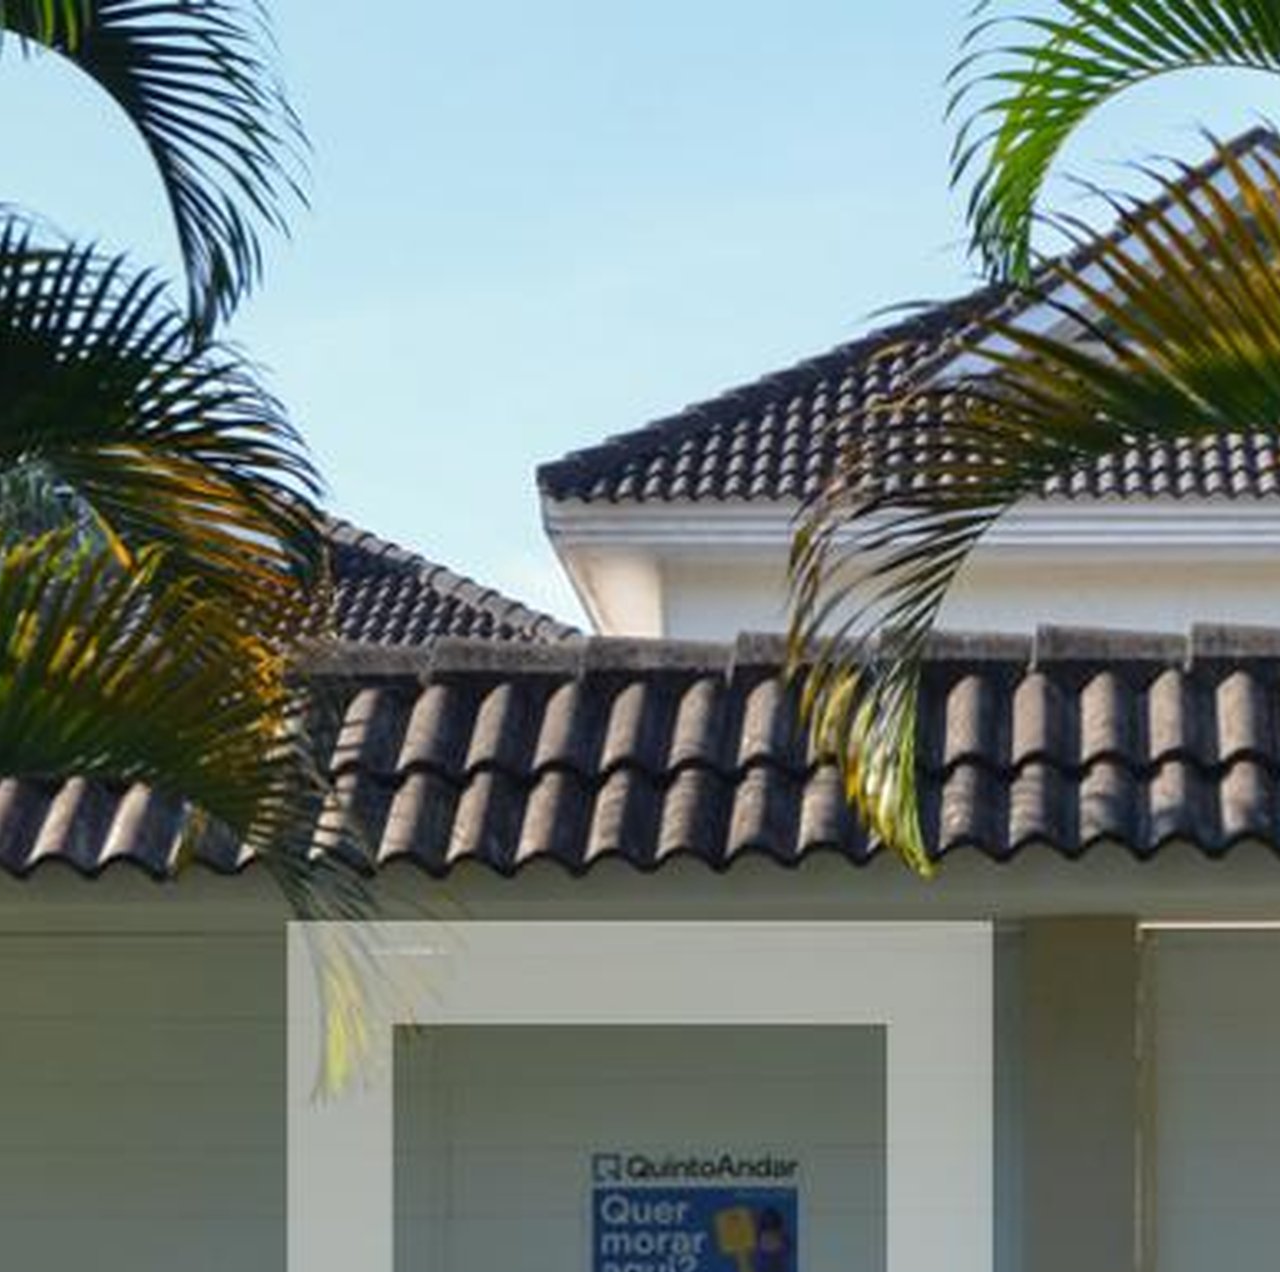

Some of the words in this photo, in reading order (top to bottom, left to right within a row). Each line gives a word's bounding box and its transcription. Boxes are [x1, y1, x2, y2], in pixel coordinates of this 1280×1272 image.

[626, 1154, 797, 1178] QuintoAndar
[600, 1195, 691, 1224] Quer
[600, 1231, 708, 1255] morar
